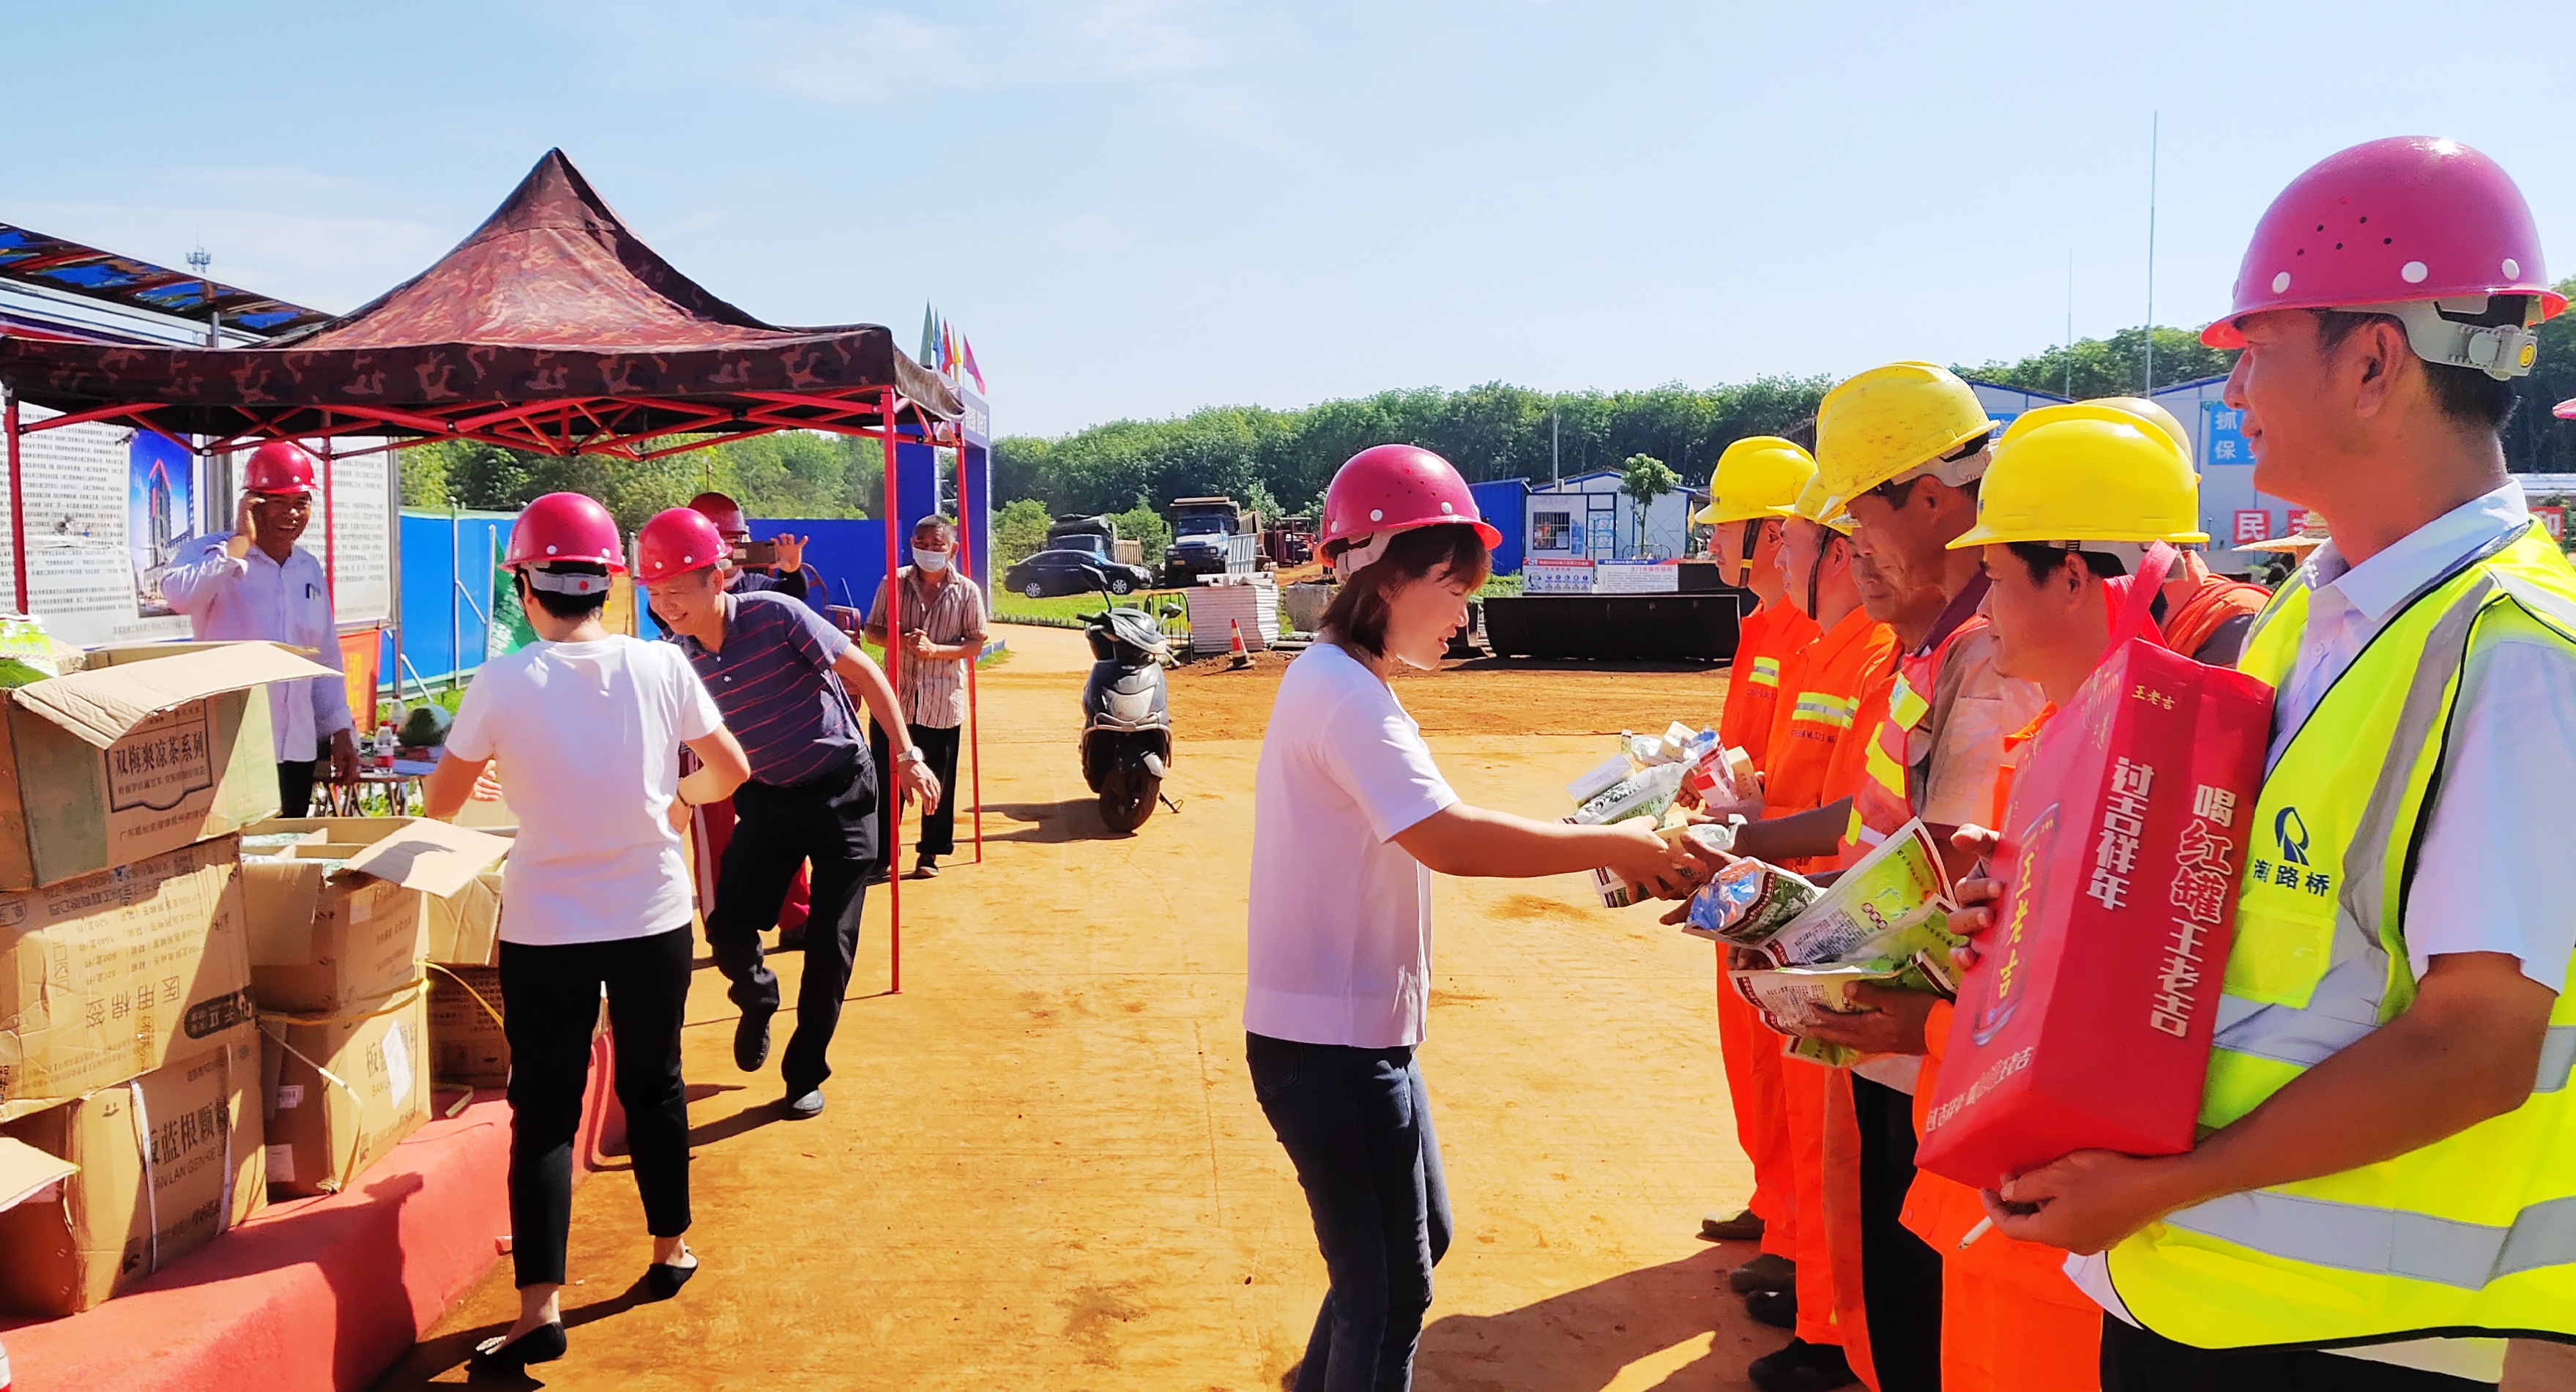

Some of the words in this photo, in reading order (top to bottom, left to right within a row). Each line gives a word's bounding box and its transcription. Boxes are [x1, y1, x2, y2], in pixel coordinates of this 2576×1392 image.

[2237, 513, 2266, 540] 民
[2131, 684, 2175, 711] 王老吉
[114, 731, 205, 777] 双梅爽凉茶系列
[2086, 756, 2155, 911] 过吉祥年
[1999, 851, 2035, 999] 王老吉
[2150, 784, 2237, 1038] 喝红罐王老吉
[85, 975, 181, 1030] 医用棉签
